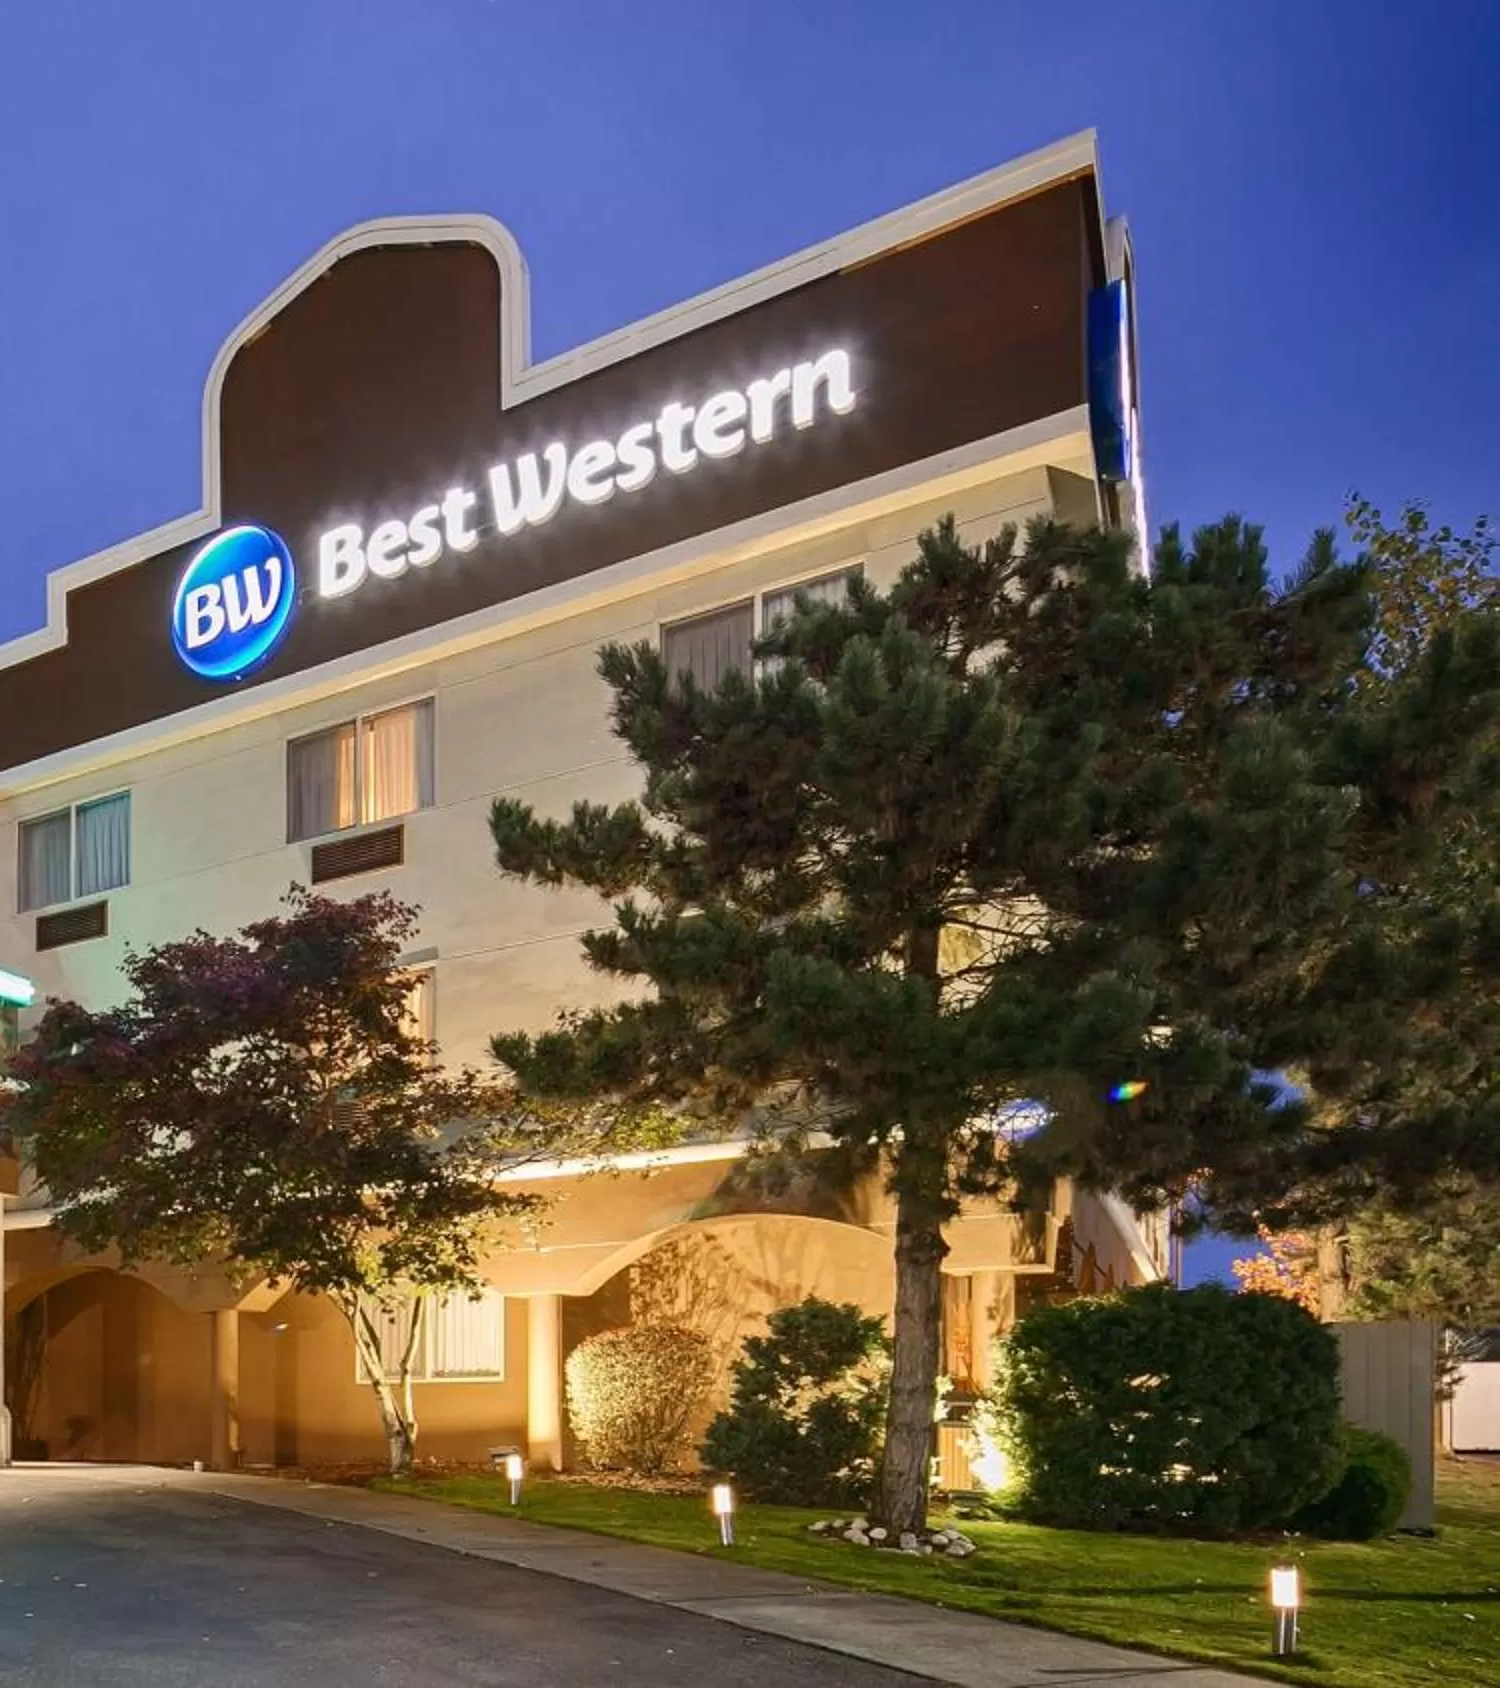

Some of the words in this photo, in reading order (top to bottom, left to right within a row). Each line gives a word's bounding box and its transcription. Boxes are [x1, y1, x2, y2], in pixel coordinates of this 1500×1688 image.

[318, 486, 477, 598] Best
[487, 348, 857, 536] Western
[185, 556, 282, 649] BW
